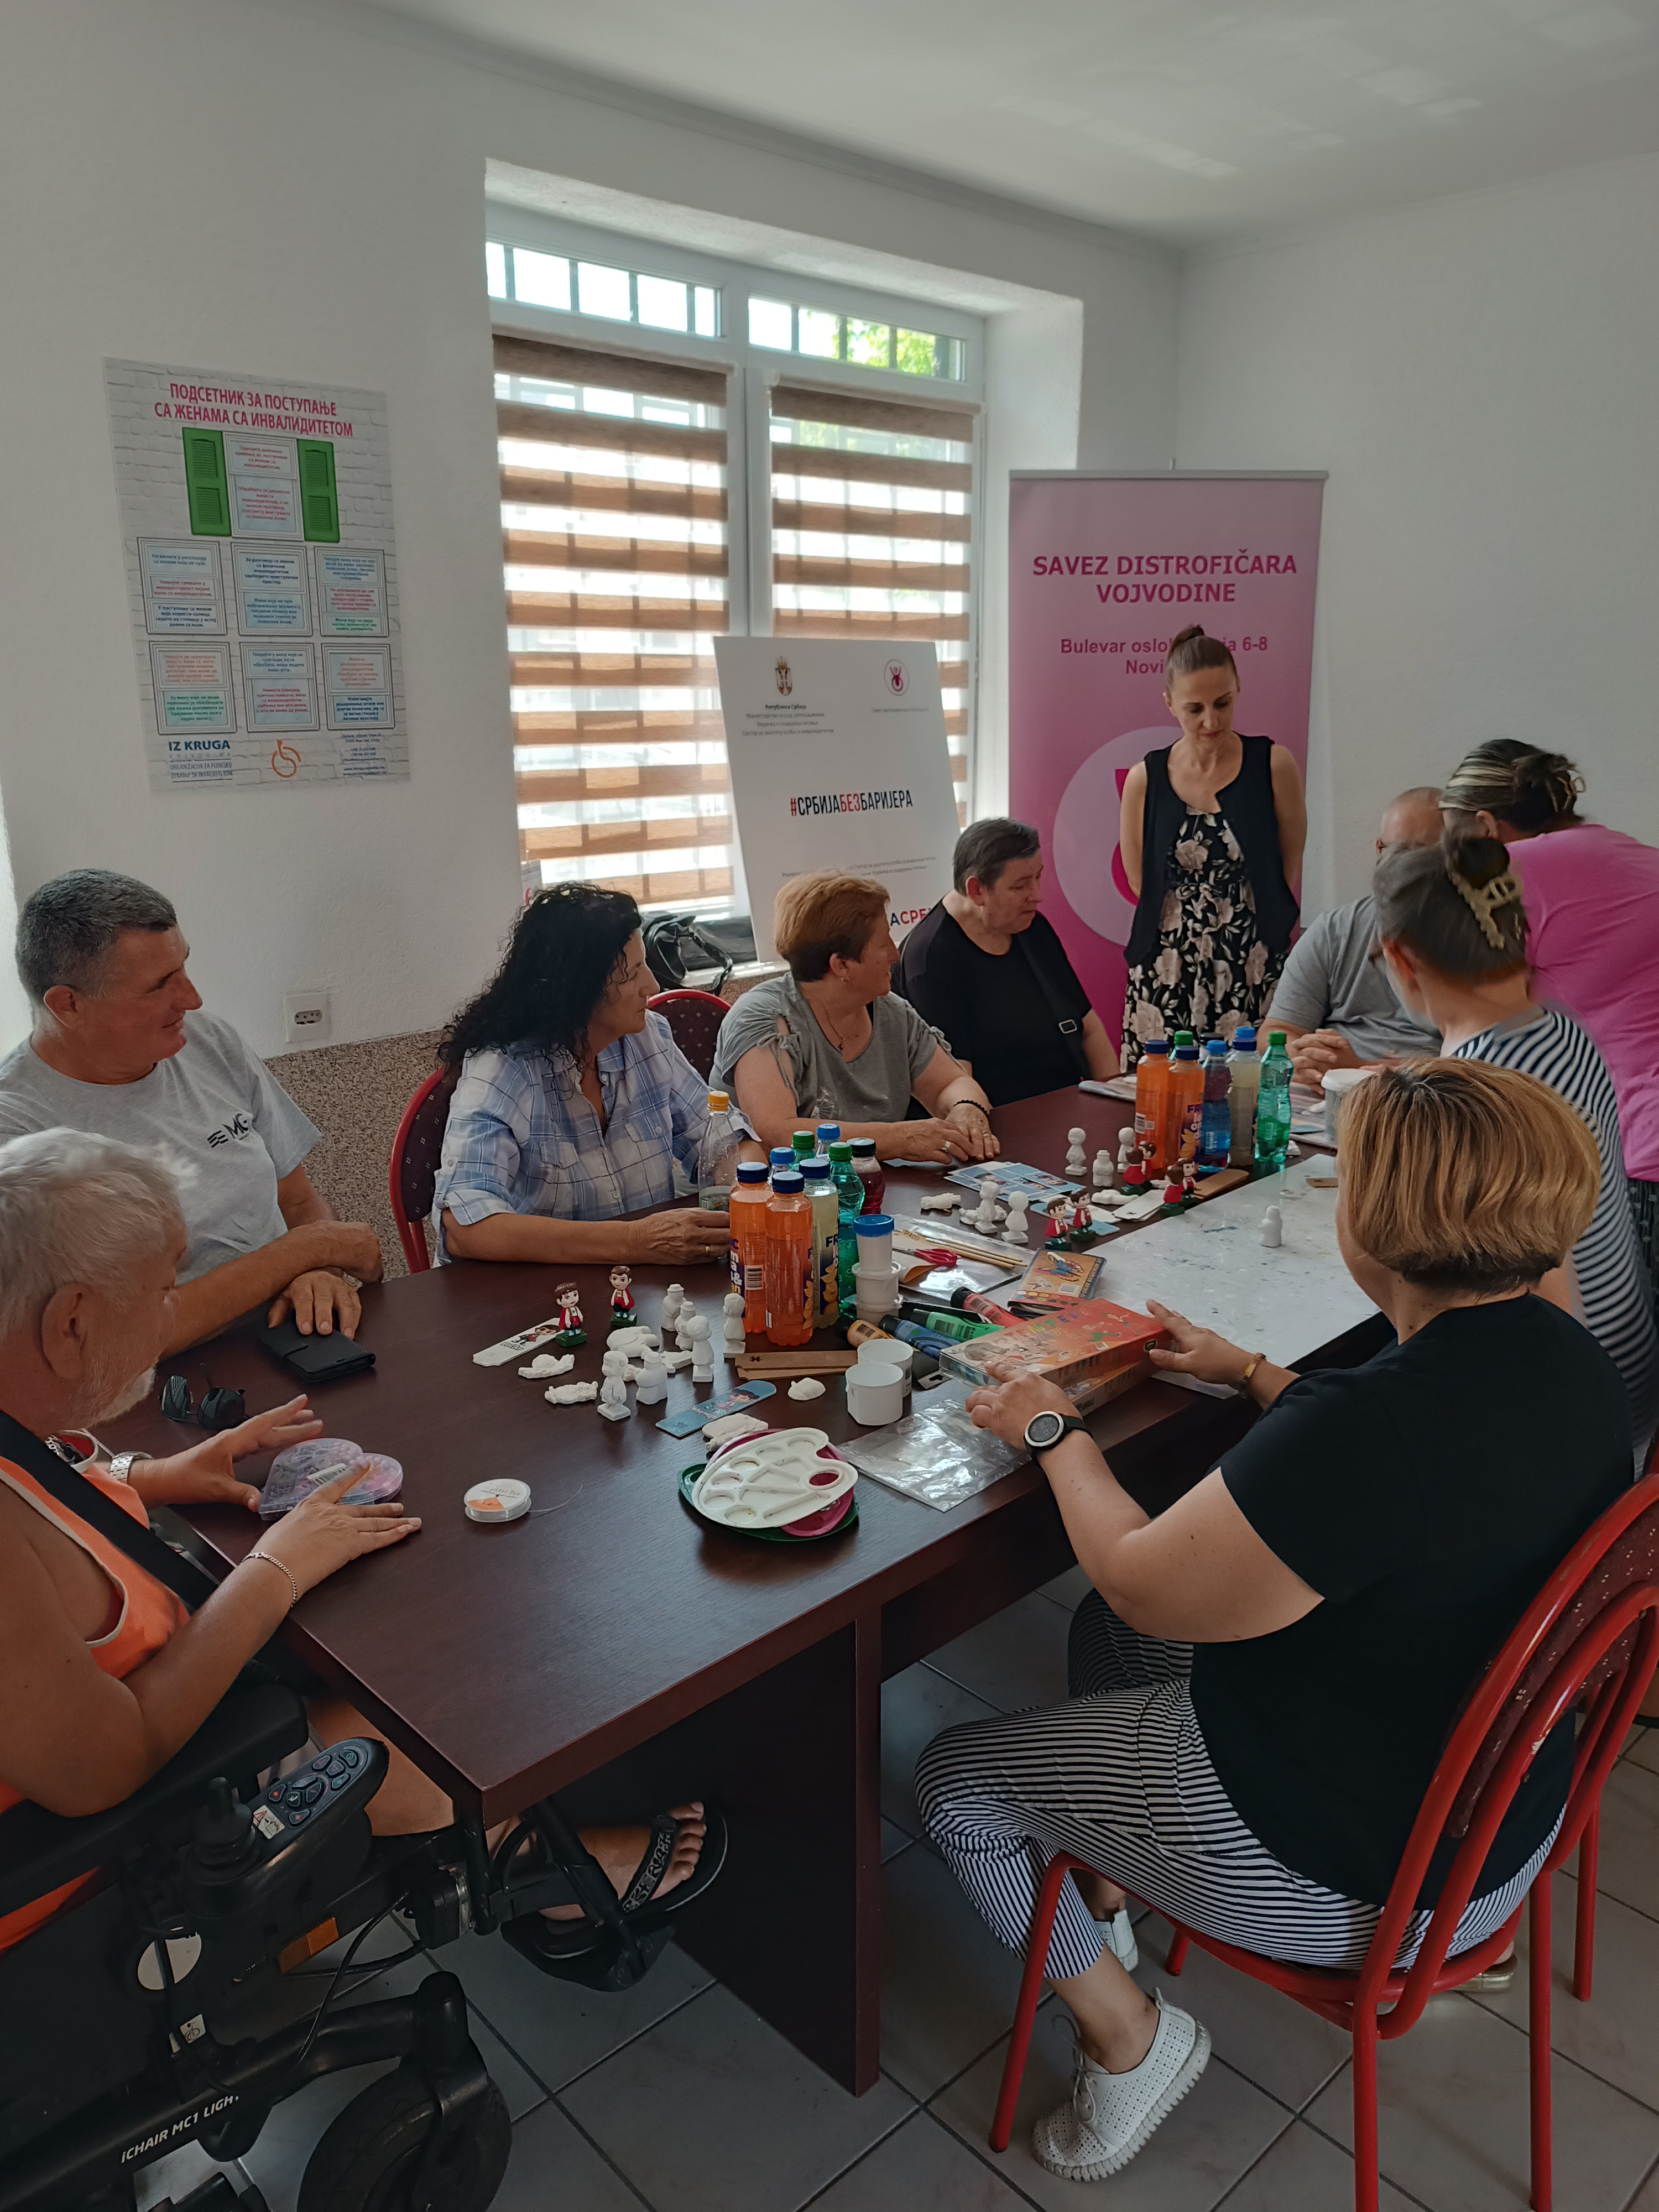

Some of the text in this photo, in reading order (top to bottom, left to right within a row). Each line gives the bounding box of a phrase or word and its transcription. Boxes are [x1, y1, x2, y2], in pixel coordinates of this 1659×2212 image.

[170, 383, 337, 416] ПОДСЕТНИК ЗА ПОСТУПАЊЕ
[155, 402, 353, 437] СА ЖЕНАМА СА ИНВАЛИДИТЕТОМ
[1033, 549, 1297, 576] SAVEZ DISTROFIČARA
[1096, 584, 1235, 603] VOJVODINE
[1061, 639, 1125, 653] Bulevar
[1242, 637, 1268, 651] 6-8
[1126, 660, 1164, 674] Novi
[169, 740, 231, 751] IZ KRUGA
[790, 790, 913, 816] #СРБИЈАБЕЗБАРИЈЕРА
[121, 2096, 239, 2163] iCHAIR MC1 LIGH
